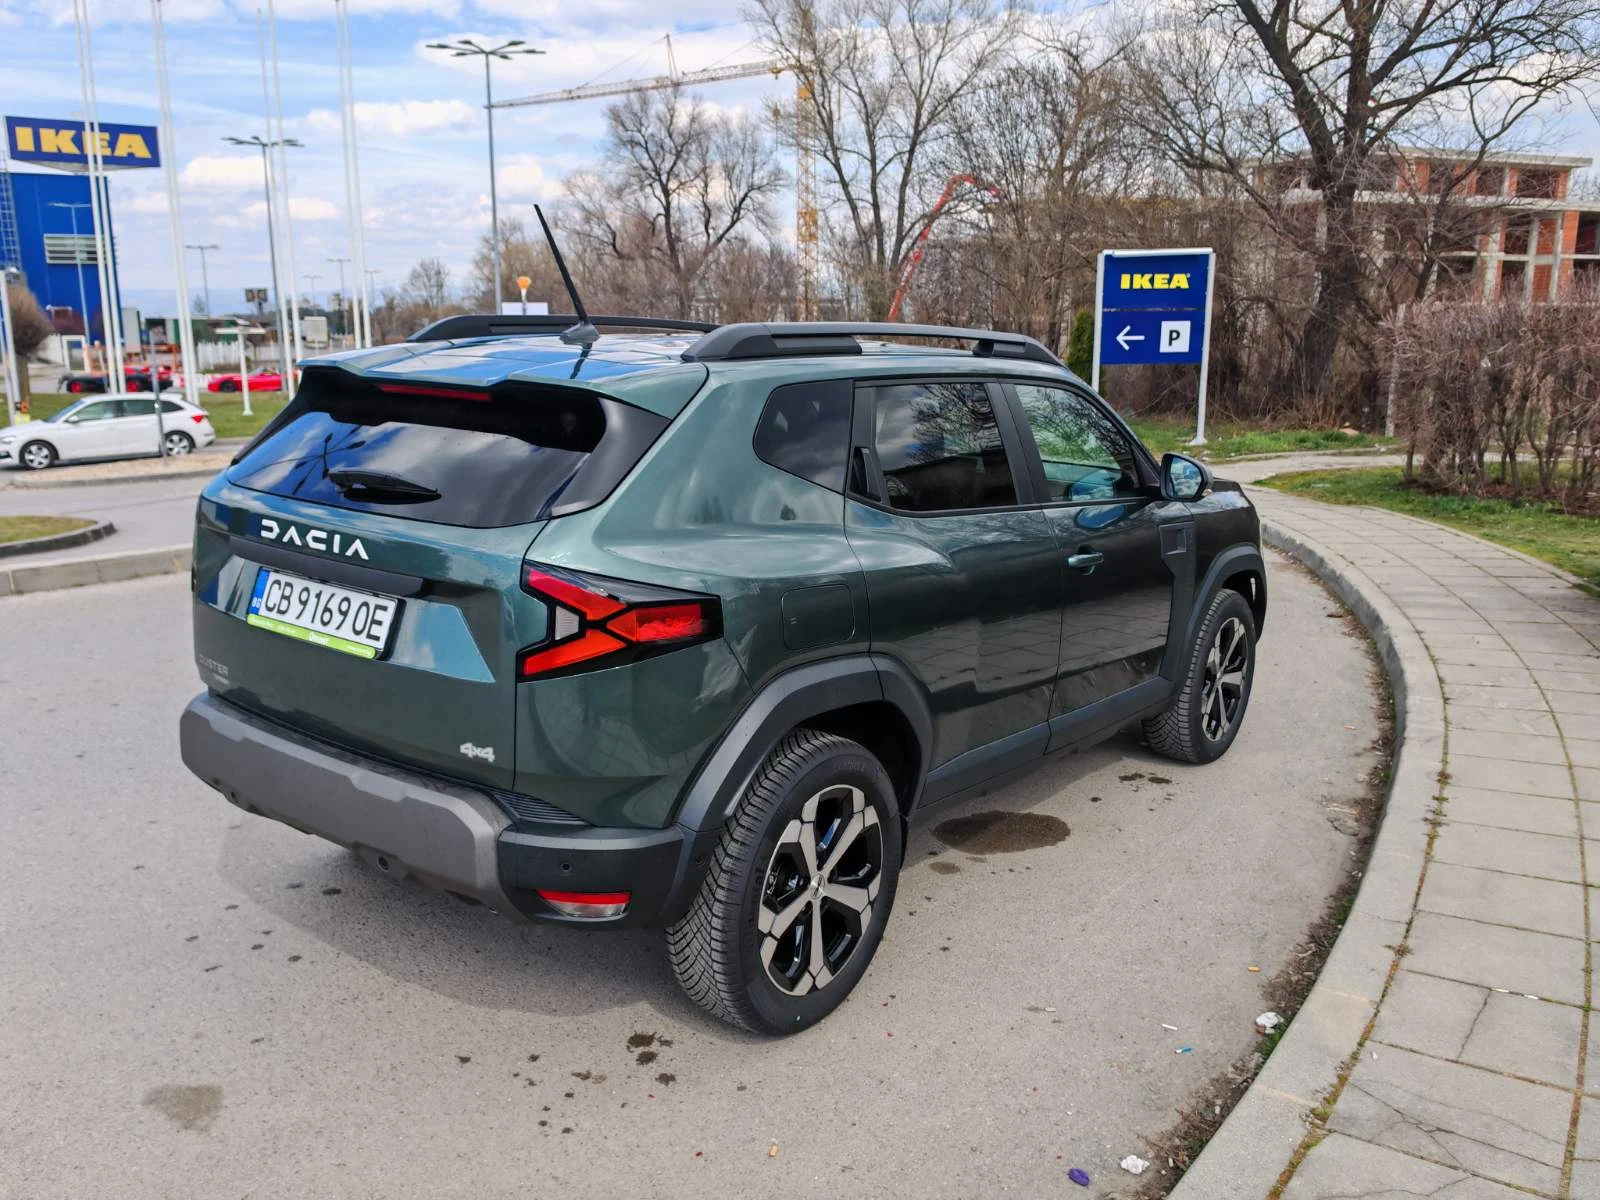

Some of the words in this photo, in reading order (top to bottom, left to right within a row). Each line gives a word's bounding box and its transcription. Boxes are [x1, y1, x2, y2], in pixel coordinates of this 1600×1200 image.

[15, 126, 152, 158] IKEA
[1120, 273, 1190, 289] IKEA
[1168, 329, 1181, 347] P
[260, 518, 370, 561] DACIA
[459, 742, 495, 763] 4x4
